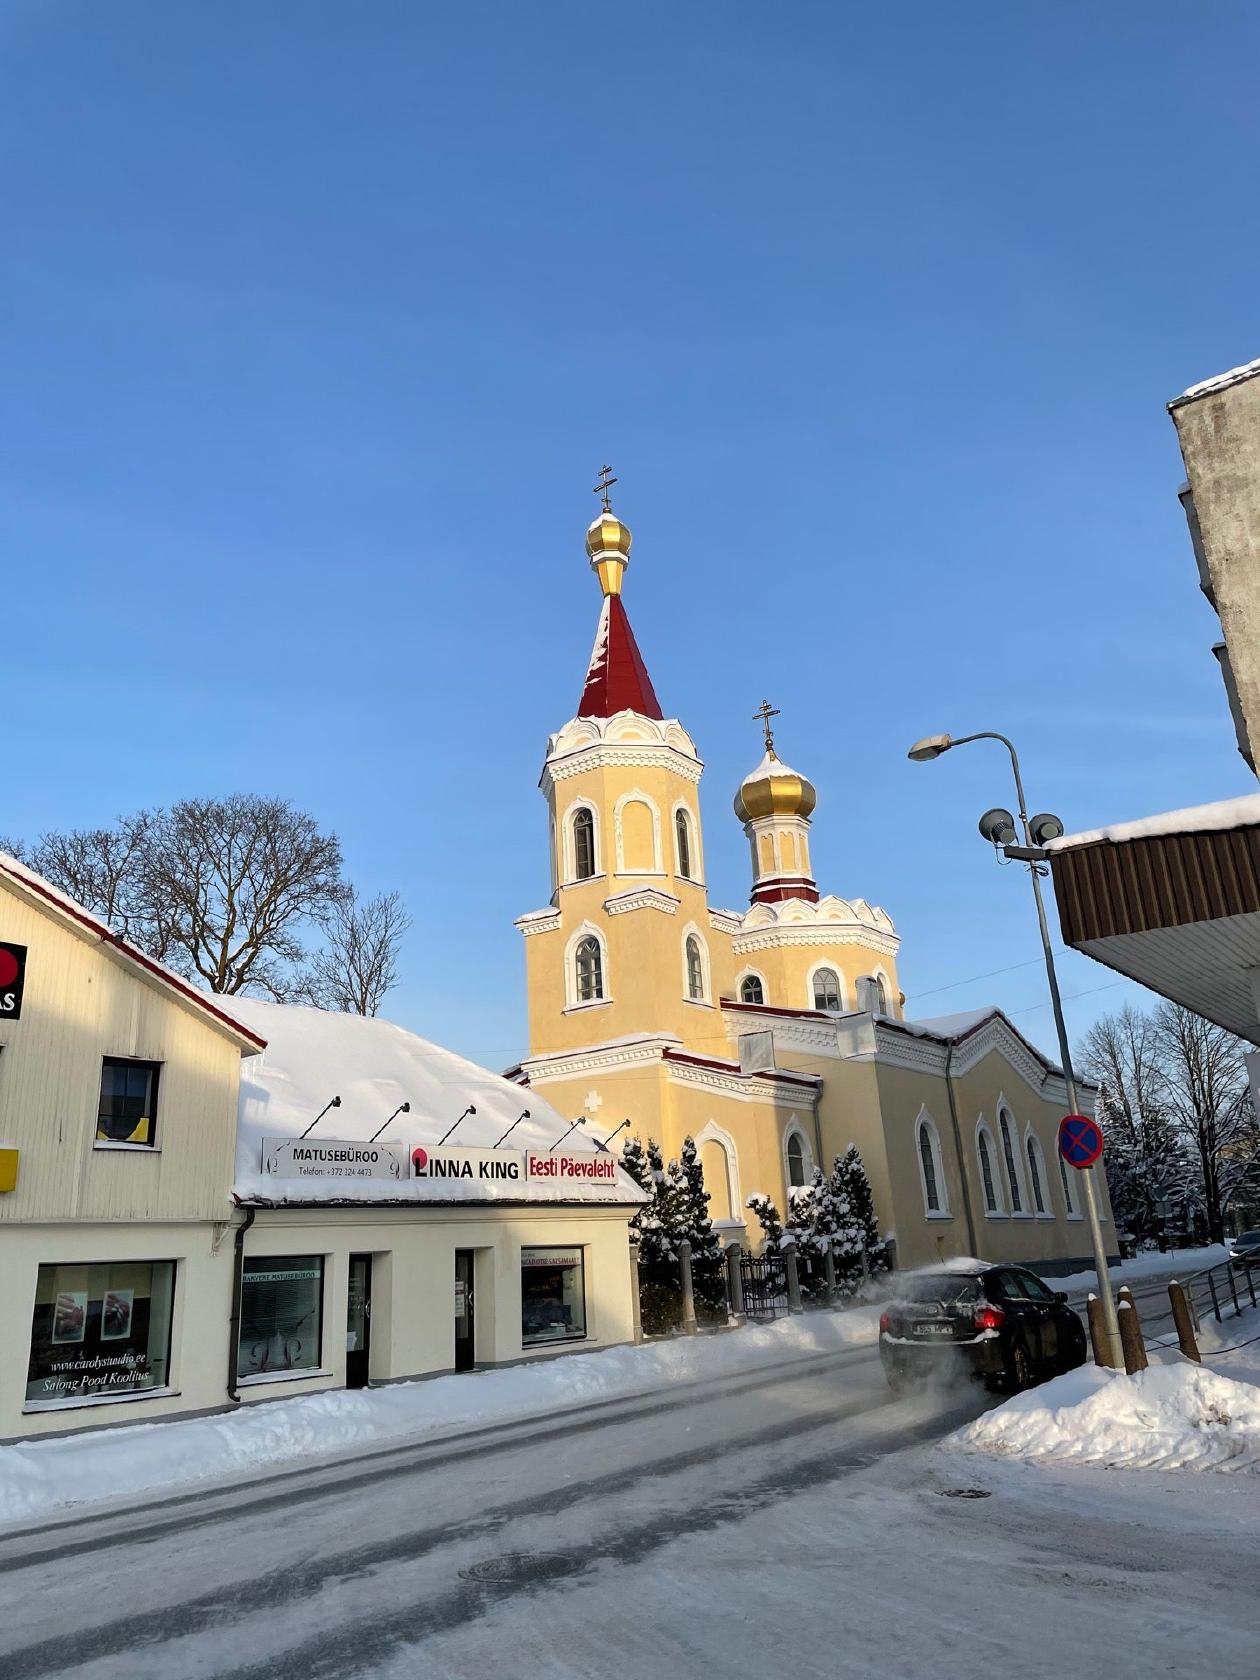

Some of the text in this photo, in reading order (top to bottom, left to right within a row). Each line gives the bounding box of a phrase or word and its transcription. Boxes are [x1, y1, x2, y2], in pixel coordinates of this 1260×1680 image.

[0, 992, 15, 1011] S
[293, 1147, 379, 1163] MATUSEBÜROO
[299, 1166, 325, 1177] Telefon:
[327, 1167, 342, 1177] +372
[415, 1157, 519, 1180] LINNA KING
[529, 1156, 616, 1179] Eesti Päevaleht
[43, 1370, 150, 1392] Salong Pood Koolitus
